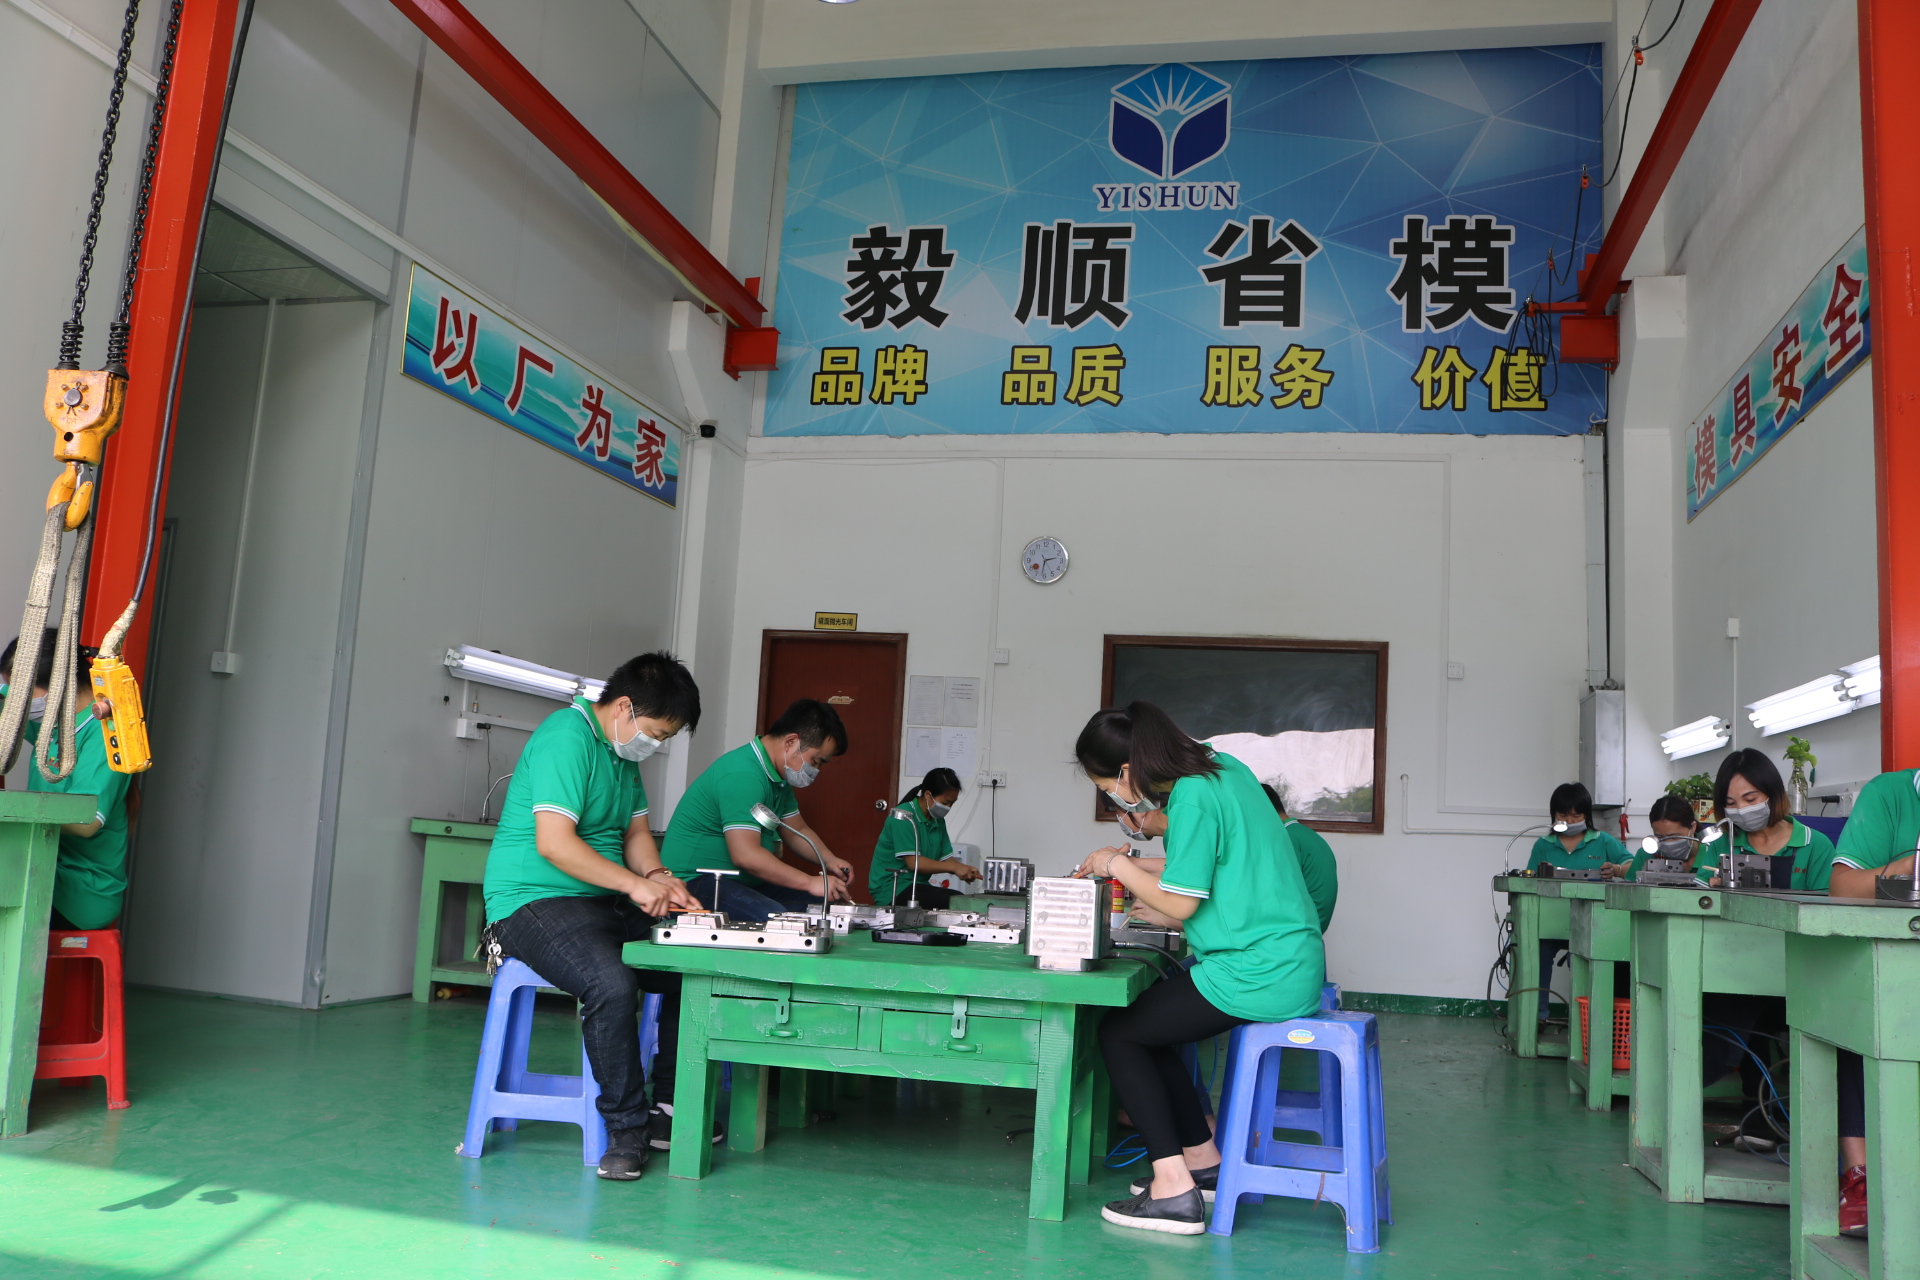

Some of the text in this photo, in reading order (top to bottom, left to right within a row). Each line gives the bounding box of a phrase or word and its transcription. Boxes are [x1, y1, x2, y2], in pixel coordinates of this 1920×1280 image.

[1095, 184, 1236, 209] YISHUN
[843, 215, 1516, 331] 毅顺省模
[432, 296, 667, 487] 以厂为家
[811, 344, 1547, 412] 品牌 品质 服务 价值
[1694, 263, 1863, 501] 模具安全
